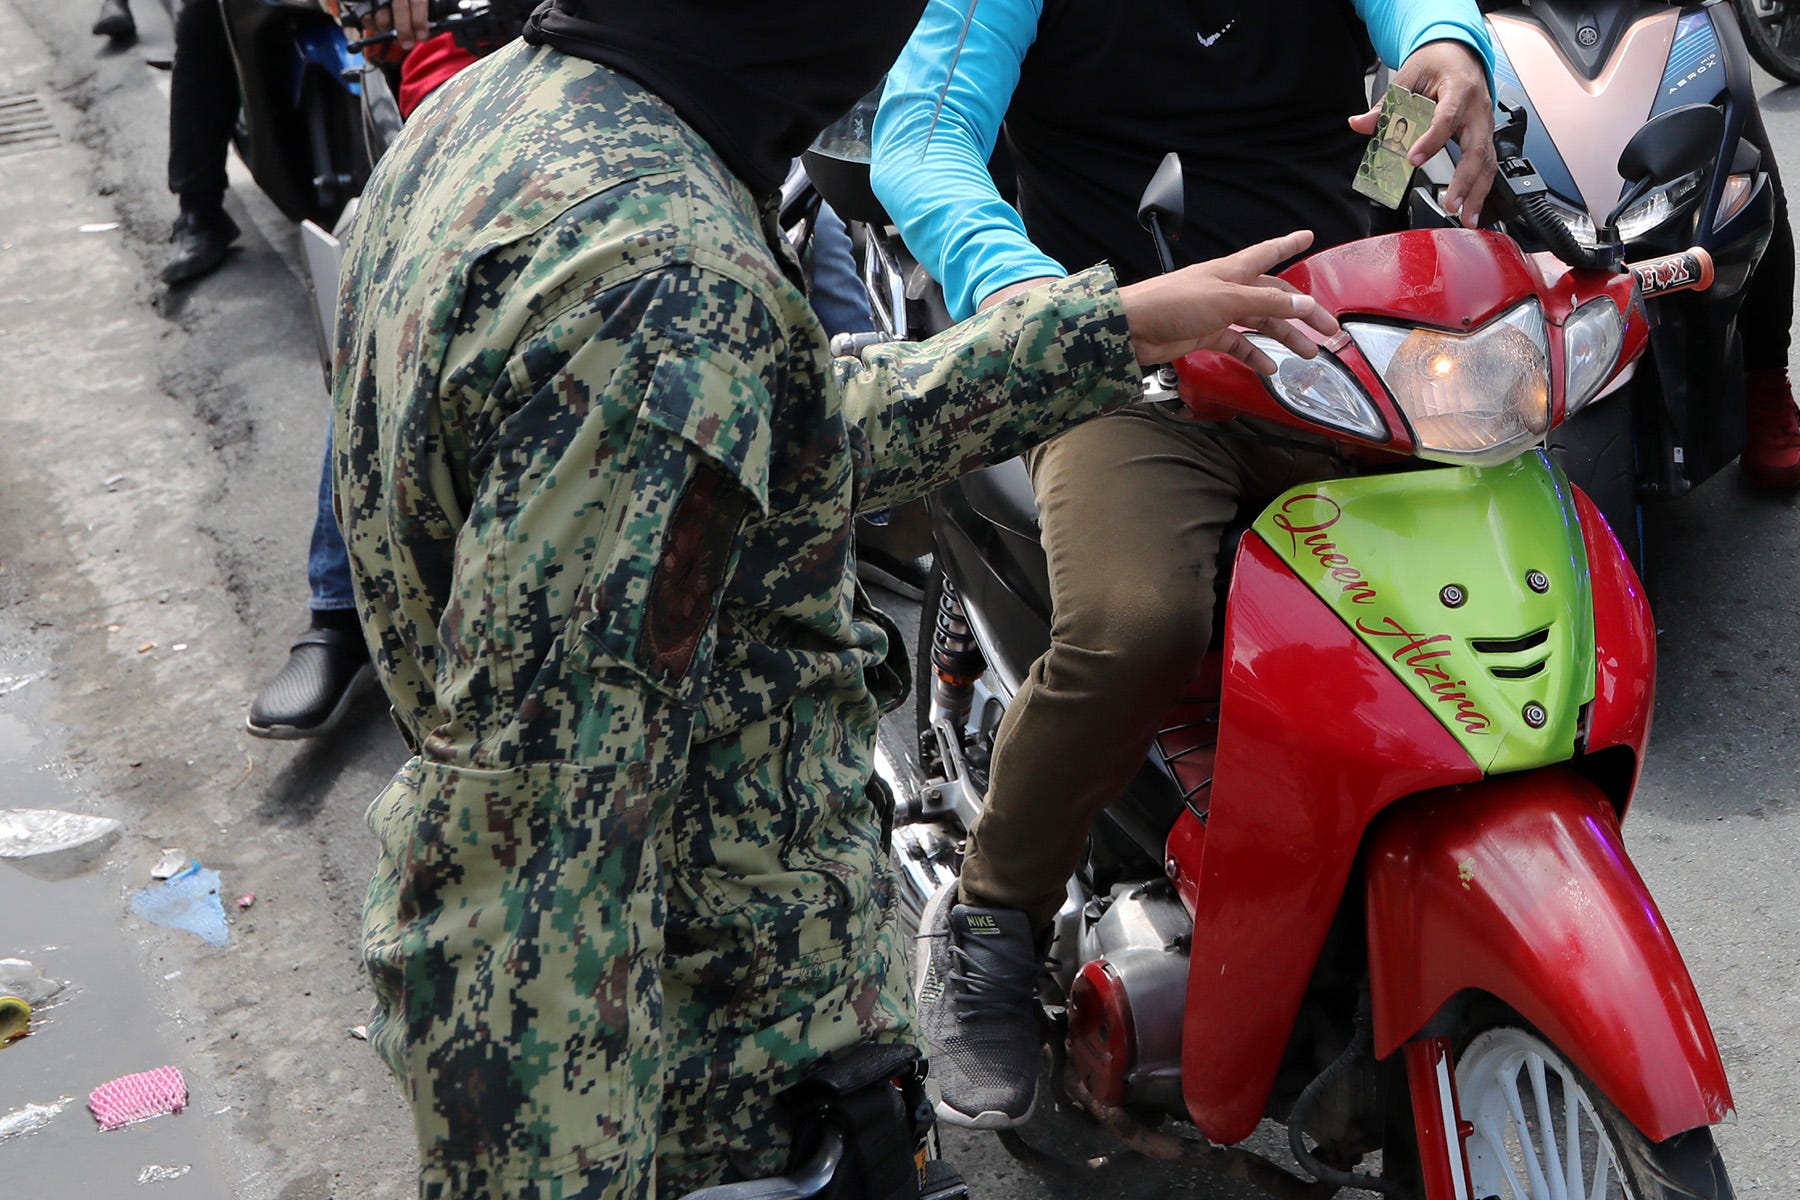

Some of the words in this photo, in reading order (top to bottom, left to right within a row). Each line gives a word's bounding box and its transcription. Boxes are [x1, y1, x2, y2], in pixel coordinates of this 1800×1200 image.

[1669, 61, 1716, 94] AEROX
[1272, 493, 1377, 605] Queen
[966, 915, 996, 927] NIKE
